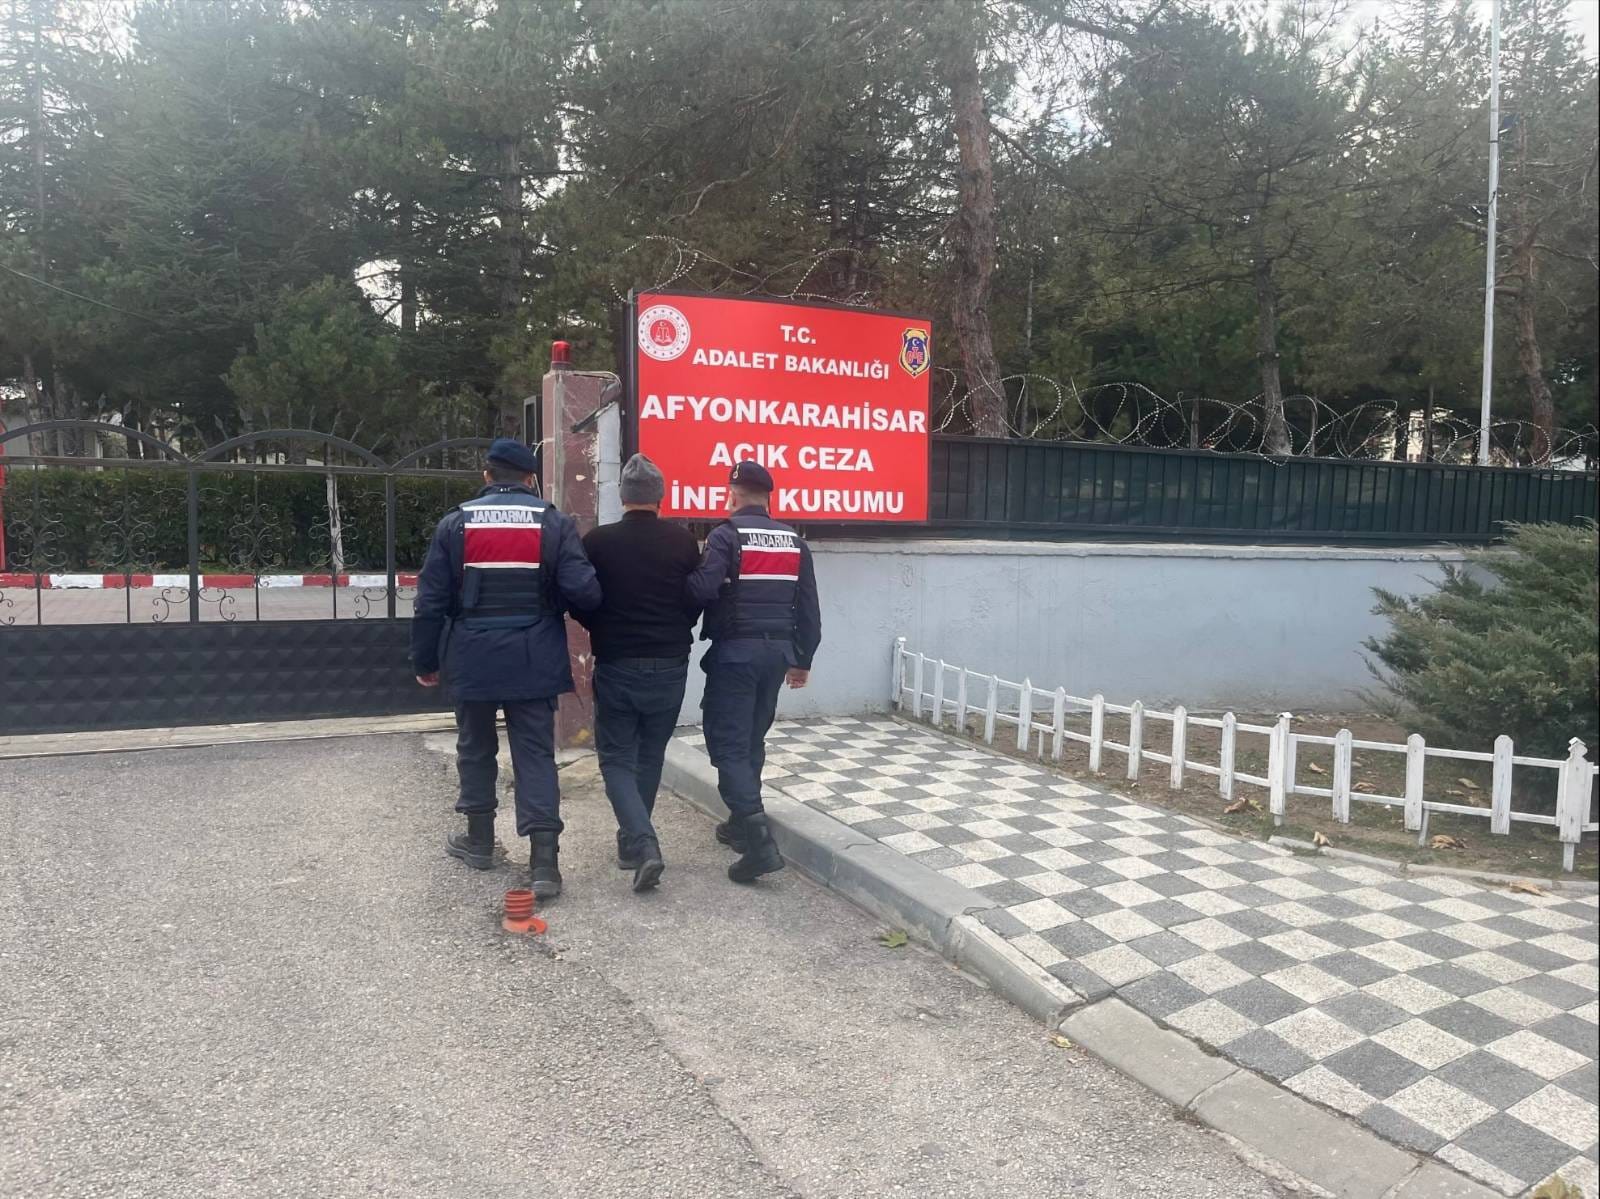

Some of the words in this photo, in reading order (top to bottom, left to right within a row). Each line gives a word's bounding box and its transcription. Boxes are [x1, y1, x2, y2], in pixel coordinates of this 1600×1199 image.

[780, 325, 817, 345] T.C.
[692, 348, 778, 371] ADALET
[784, 354, 889, 380] BAKANLIĞI
[640, 395, 926, 434] AFYONKARAHİSAR
[798, 446, 874, 472] CEZA
[671, 480, 731, 511] İNF
[778, 488, 904, 514] KURUMU
[470, 510, 534, 523] JANDARMA
[747, 533, 796, 548] JANDARMA
